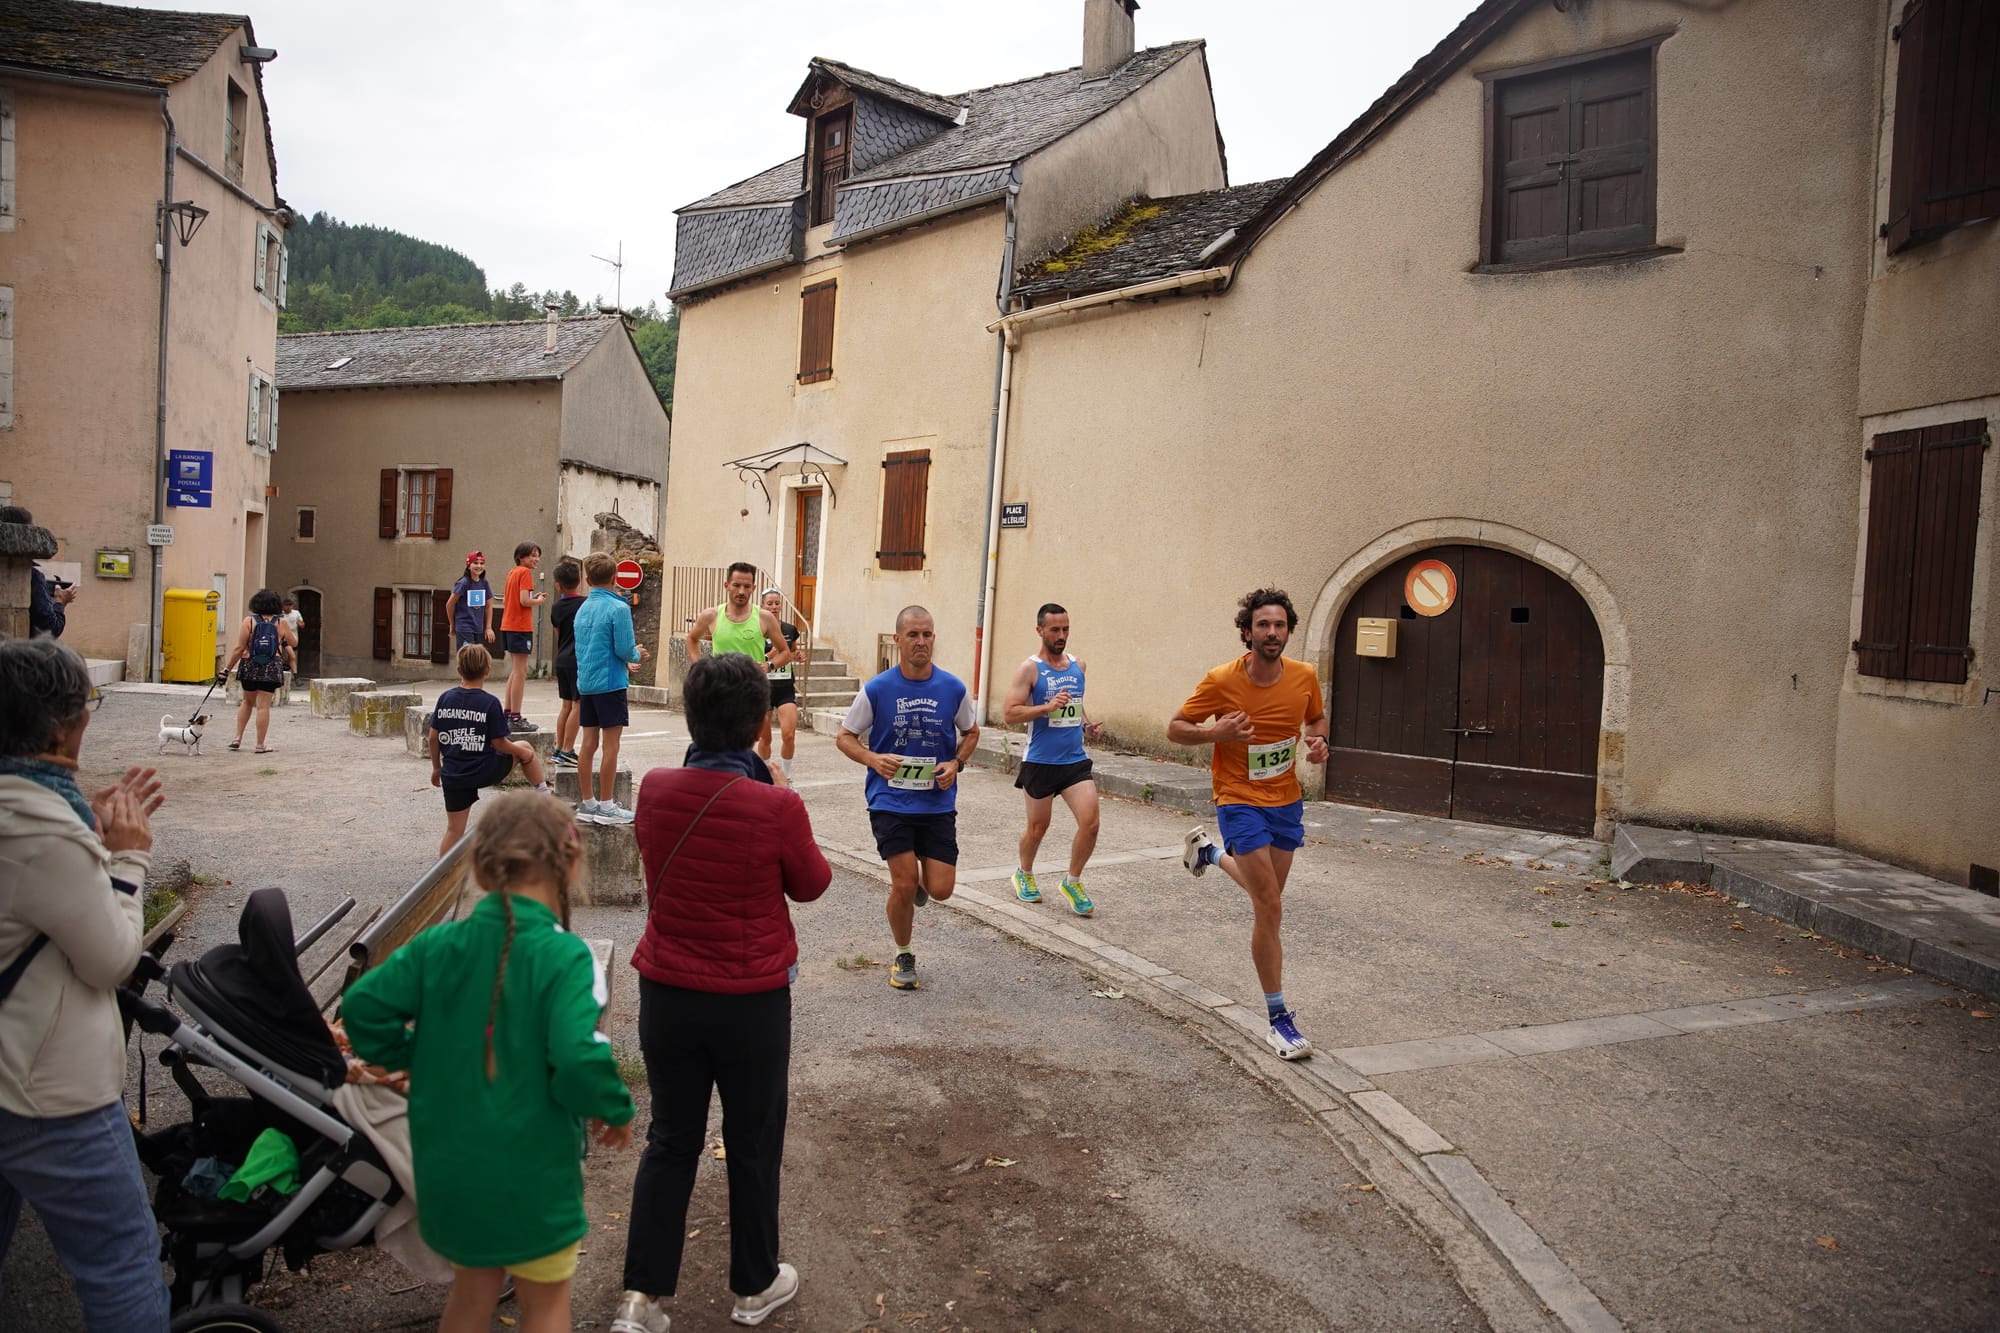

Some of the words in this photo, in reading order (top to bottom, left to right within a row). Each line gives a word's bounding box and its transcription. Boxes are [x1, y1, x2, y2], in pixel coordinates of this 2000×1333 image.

[1006, 506, 1022, 514] PLACE
[438, 708, 487, 722] ORGANISATION
[1060, 705, 1076, 718] 70
[1257, 748, 1290, 768] 132
[902, 765, 924, 779] 77
